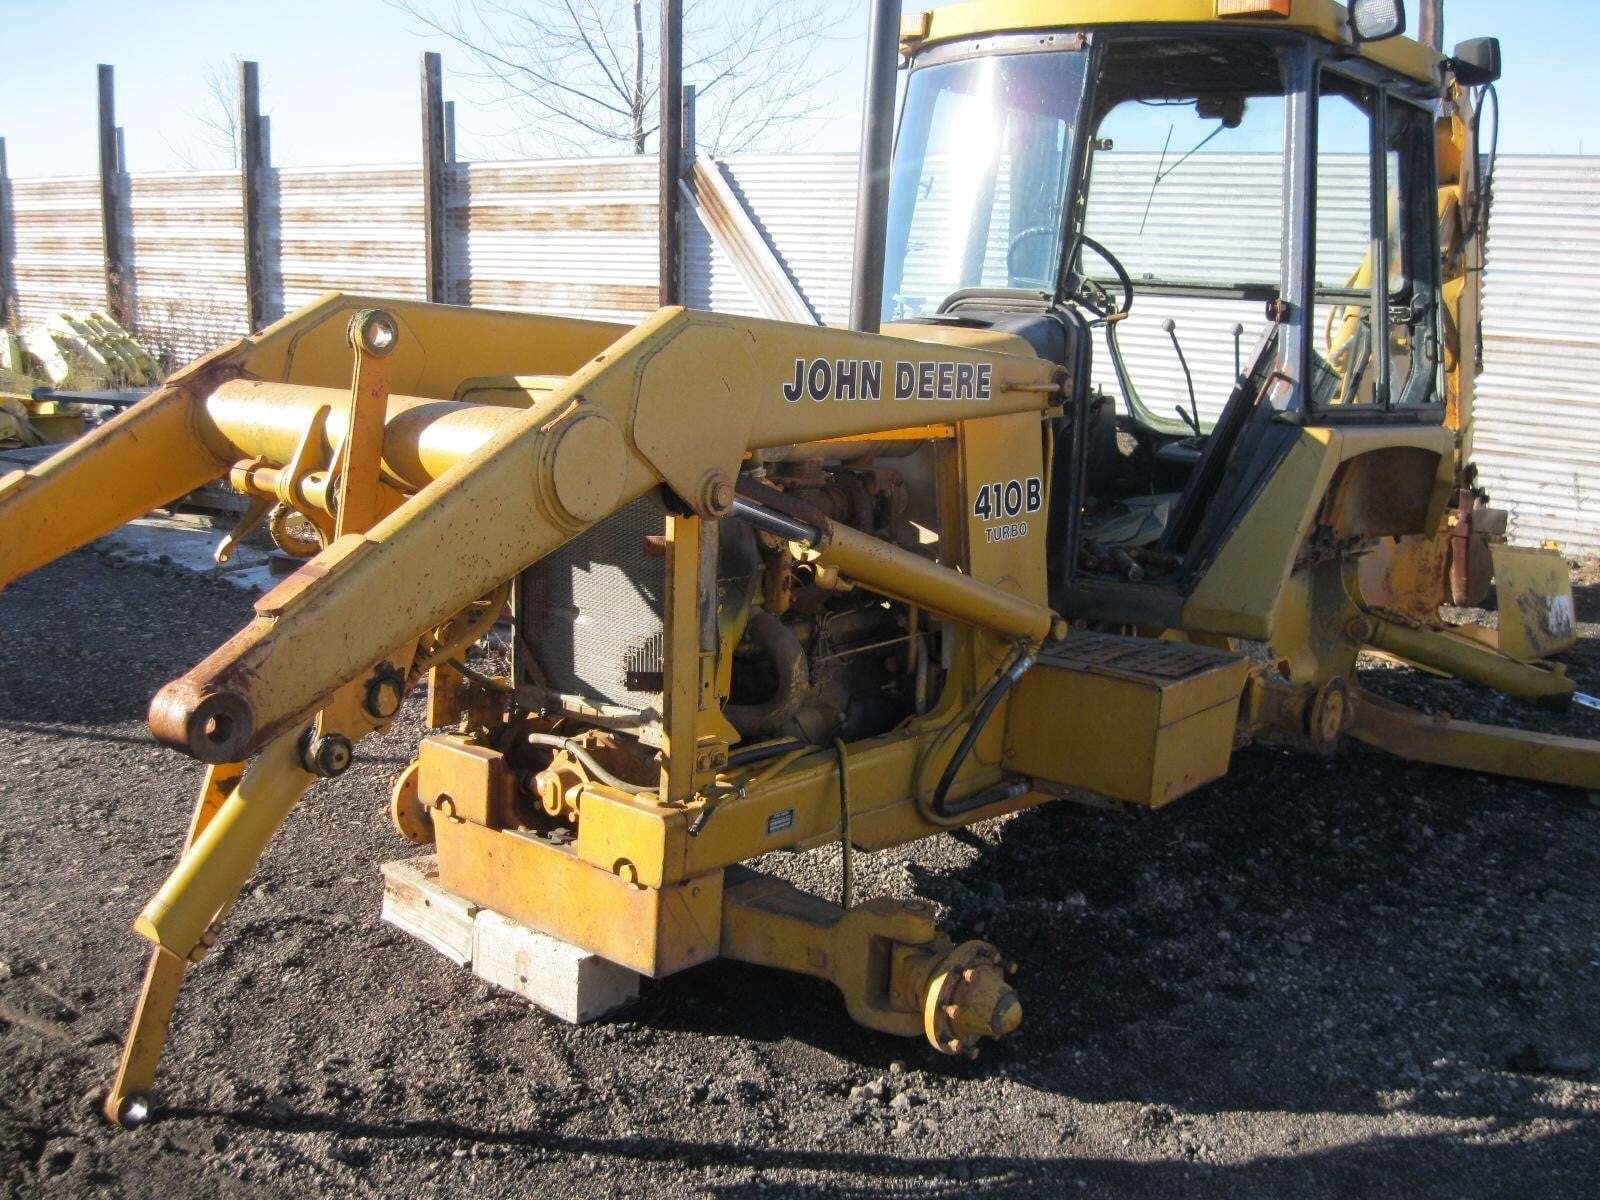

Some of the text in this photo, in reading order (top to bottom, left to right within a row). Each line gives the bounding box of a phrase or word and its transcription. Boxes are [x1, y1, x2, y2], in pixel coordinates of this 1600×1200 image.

[783, 358, 993, 402] JOHN DEERE
[973, 477, 1042, 521] 410B
[985, 521, 1028, 543] TURBO
